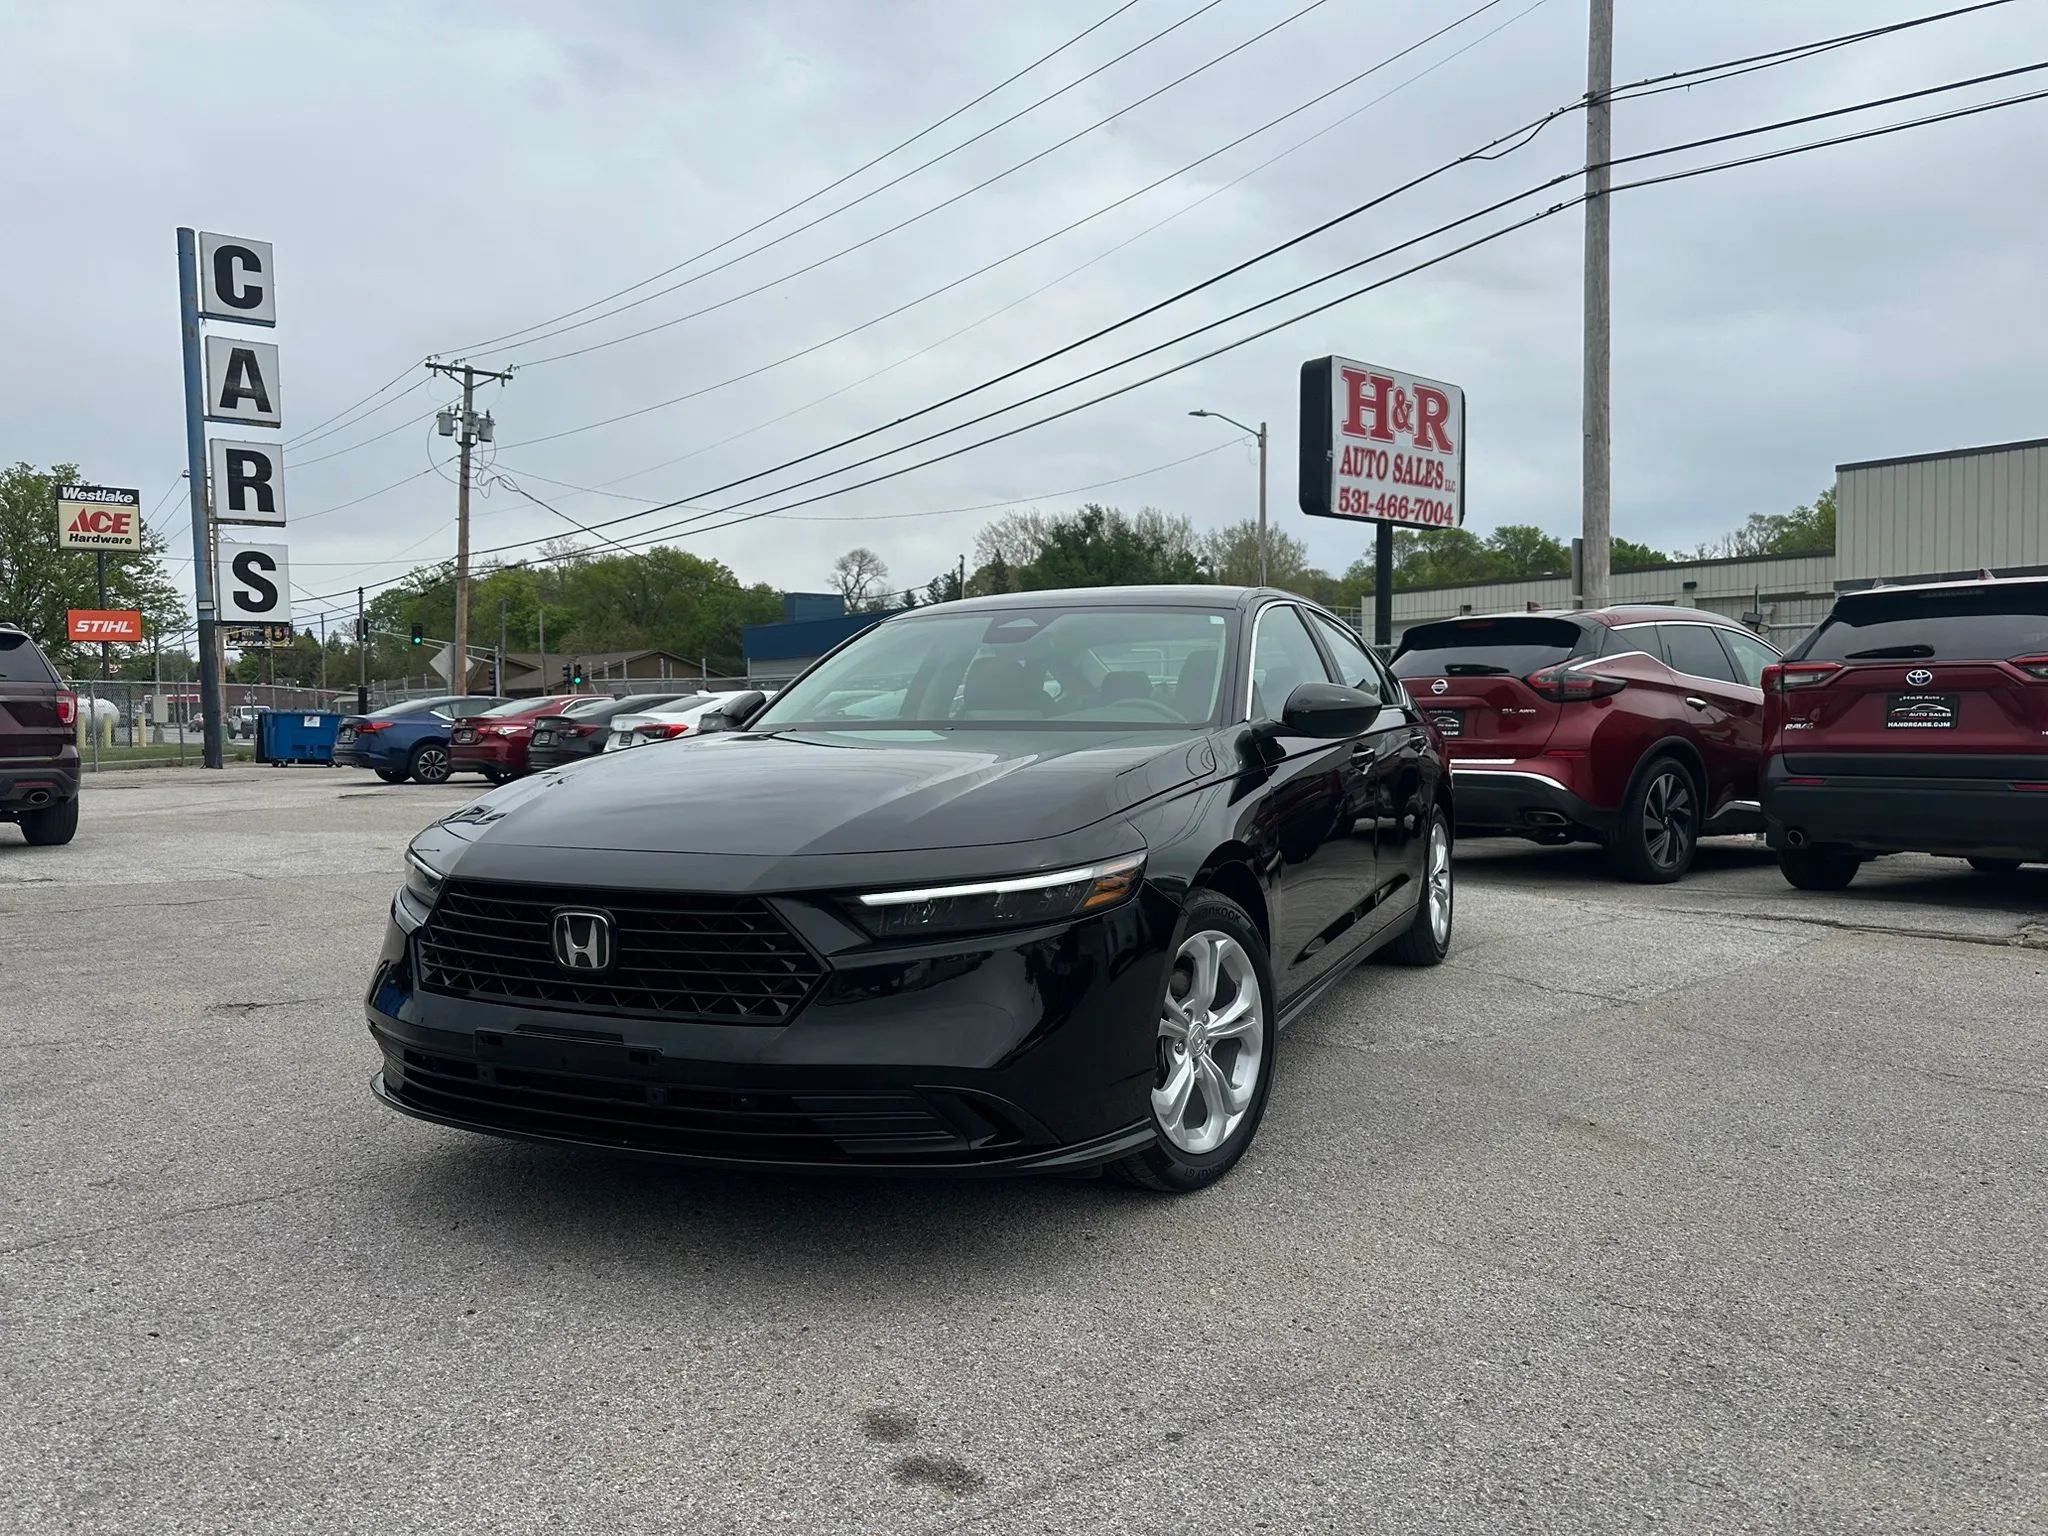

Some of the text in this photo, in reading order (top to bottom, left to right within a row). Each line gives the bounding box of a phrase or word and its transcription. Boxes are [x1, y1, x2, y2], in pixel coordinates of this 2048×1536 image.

[1341, 366, 1454, 455] H&R
[213, 244, 278, 613] CARS
[1339, 445, 1388, 480] AUTO
[1392, 452, 1444, 489] SALES
[62, 486, 134, 503] Westlake
[1338, 486, 1454, 526] 531-466-7004
[67, 507, 132, 535] ACE
[68, 533, 132, 545] Hardware
[74, 620, 134, 633] STIHL
